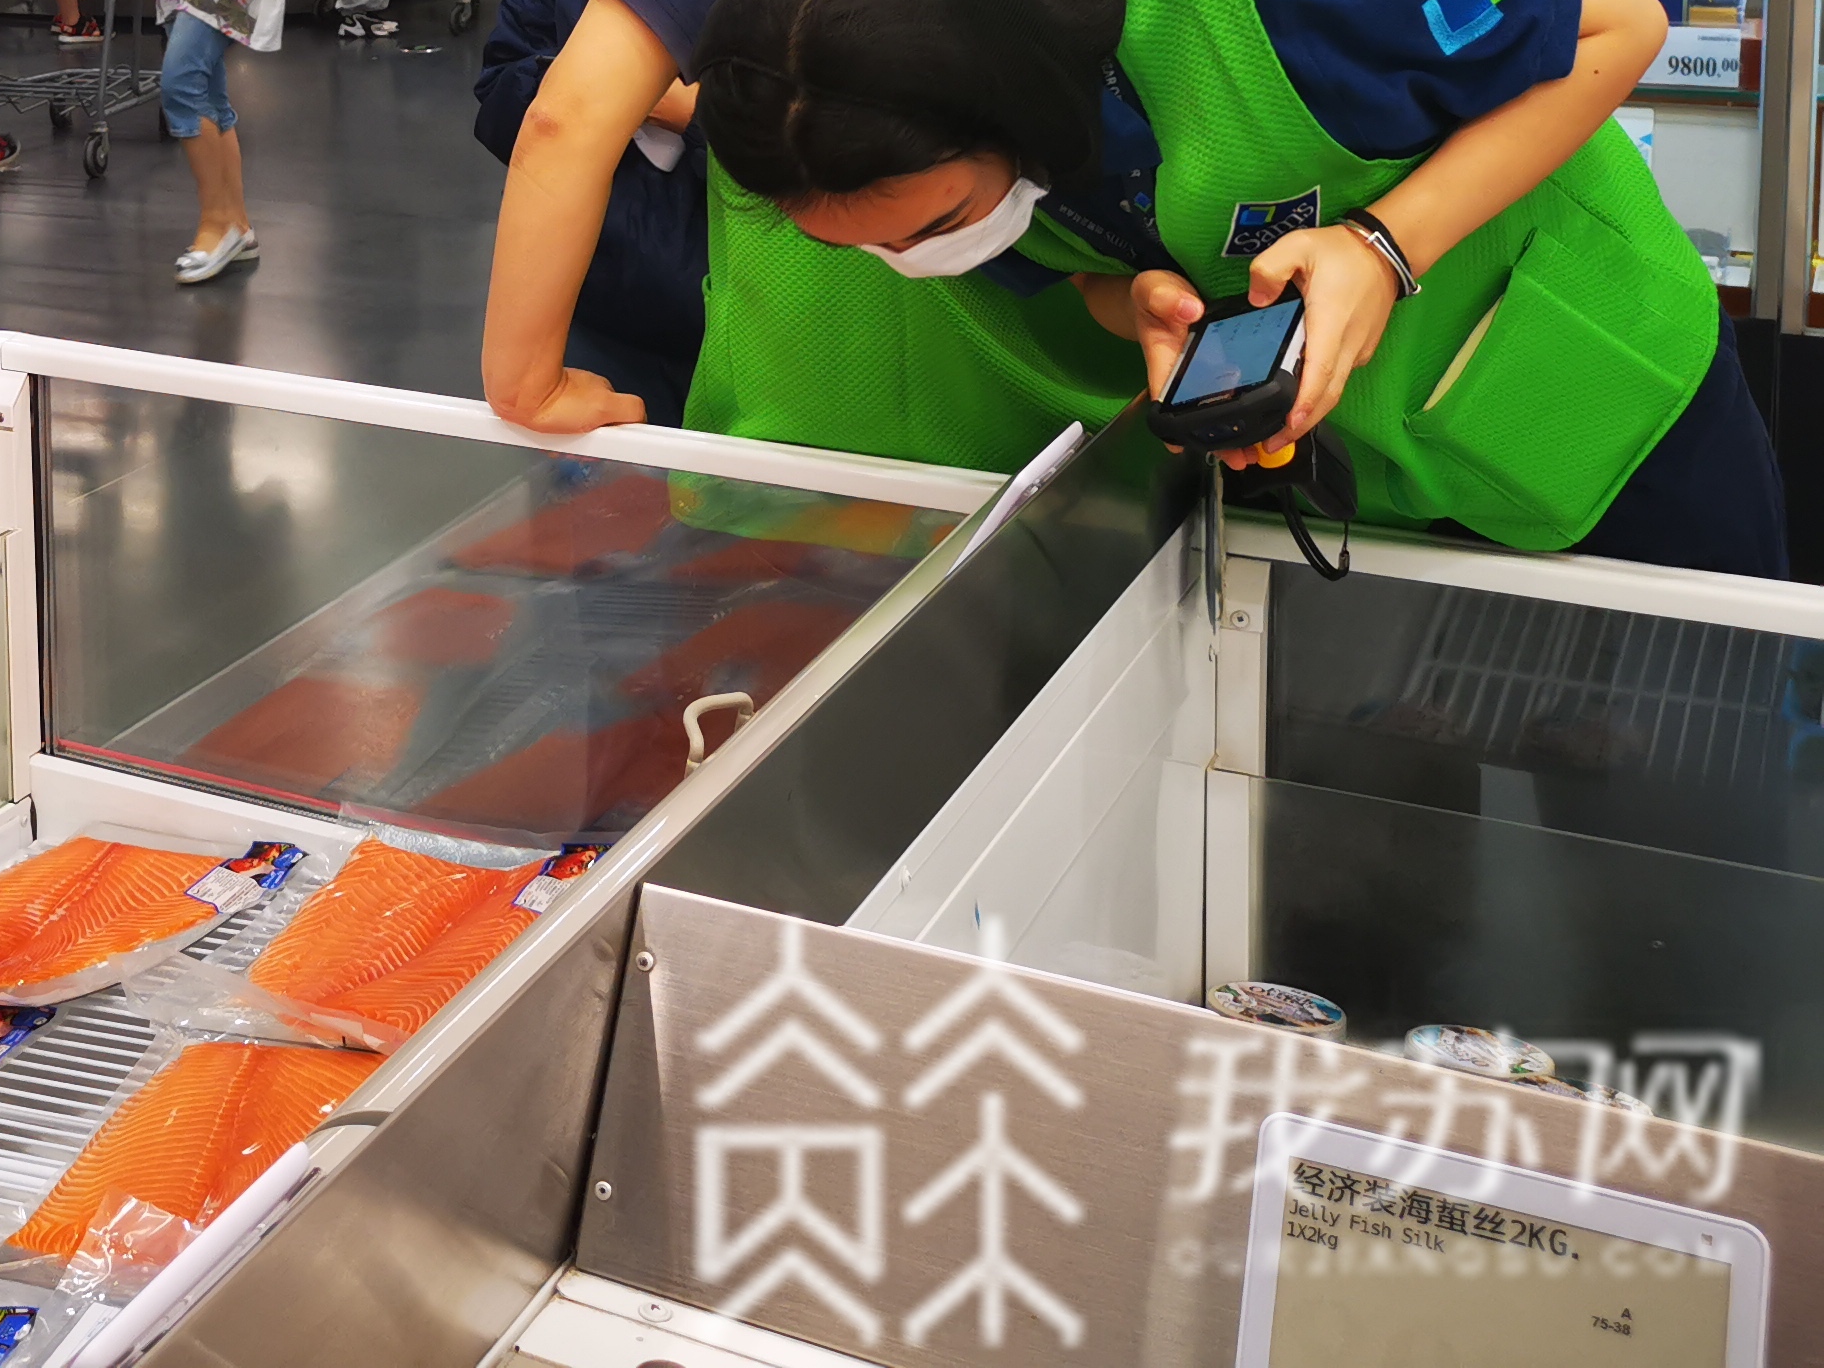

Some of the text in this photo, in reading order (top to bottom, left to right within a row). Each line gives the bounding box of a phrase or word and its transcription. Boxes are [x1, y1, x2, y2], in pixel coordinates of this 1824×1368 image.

[1667, 55, 1739, 79] 9800.00
[1291, 1161, 1581, 1262] 经济装海蜇丝2KG.
[1286, 1221, 1339, 1251] 1X2kg
[1287, 1198, 1446, 1254] Jelly Fish Silk
[1590, 1315, 1632, 1336] 75-38
[1620, 1307, 1633, 1321] A
